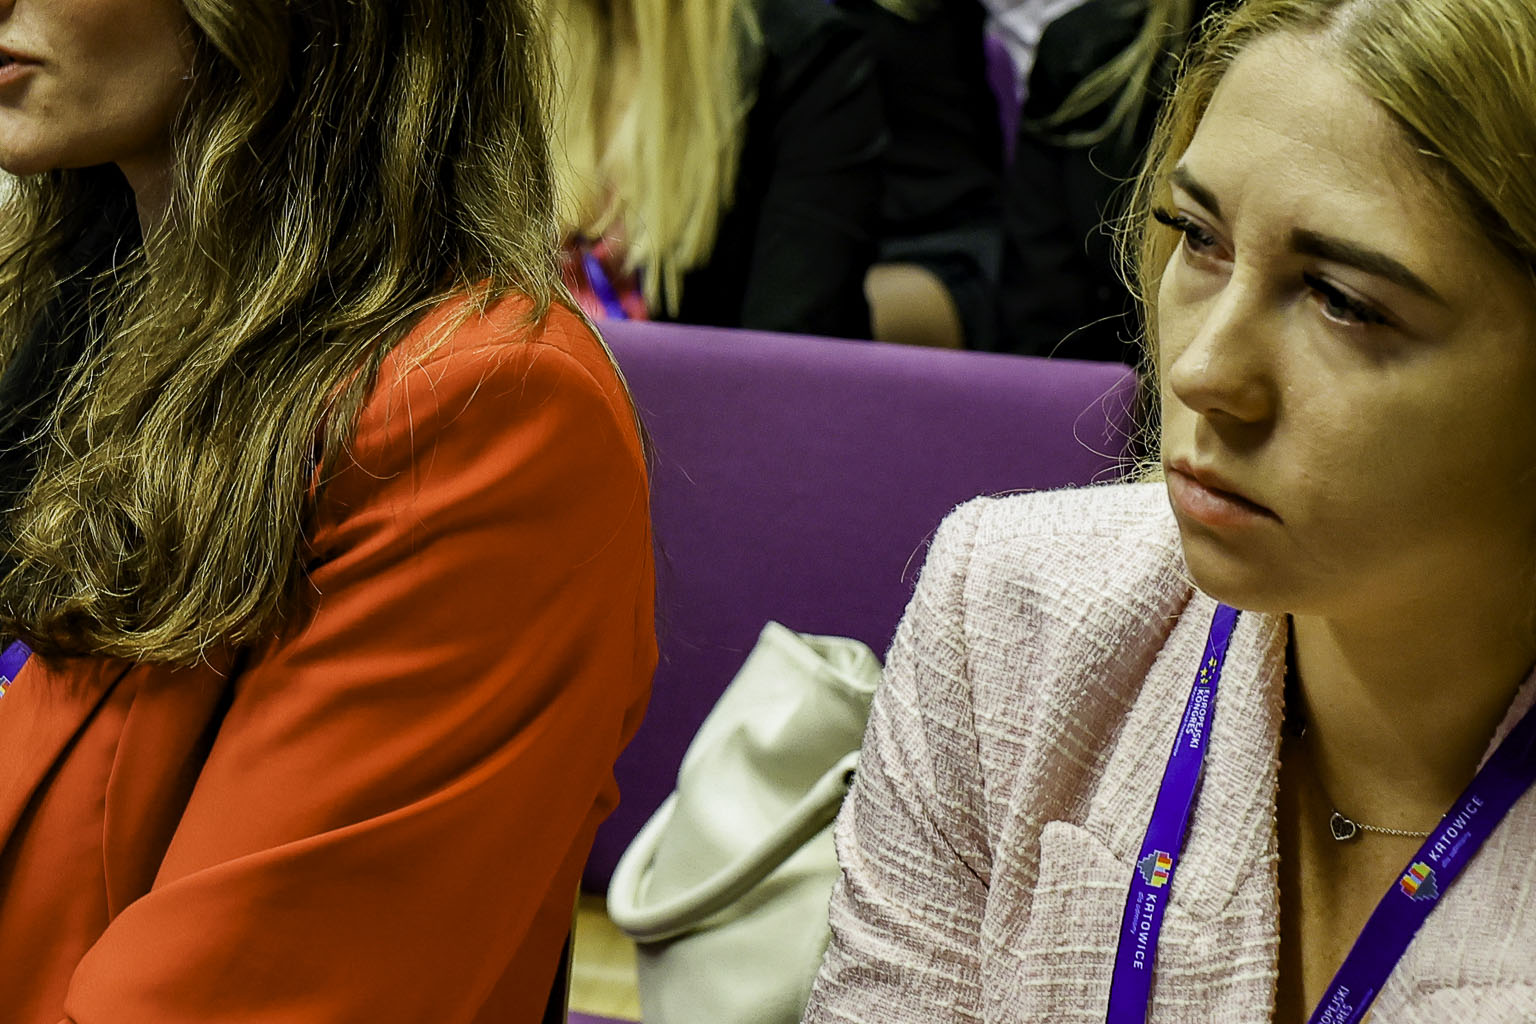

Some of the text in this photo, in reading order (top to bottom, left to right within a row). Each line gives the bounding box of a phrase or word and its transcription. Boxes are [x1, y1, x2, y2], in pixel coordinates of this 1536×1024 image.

[1185, 689, 1205, 735] KONGRES
[1189, 689, 1211, 749] EUROPEJSKI
[1428, 796, 1484, 862] KATOWICE
[1133, 893, 1158, 971] KATOWICE
